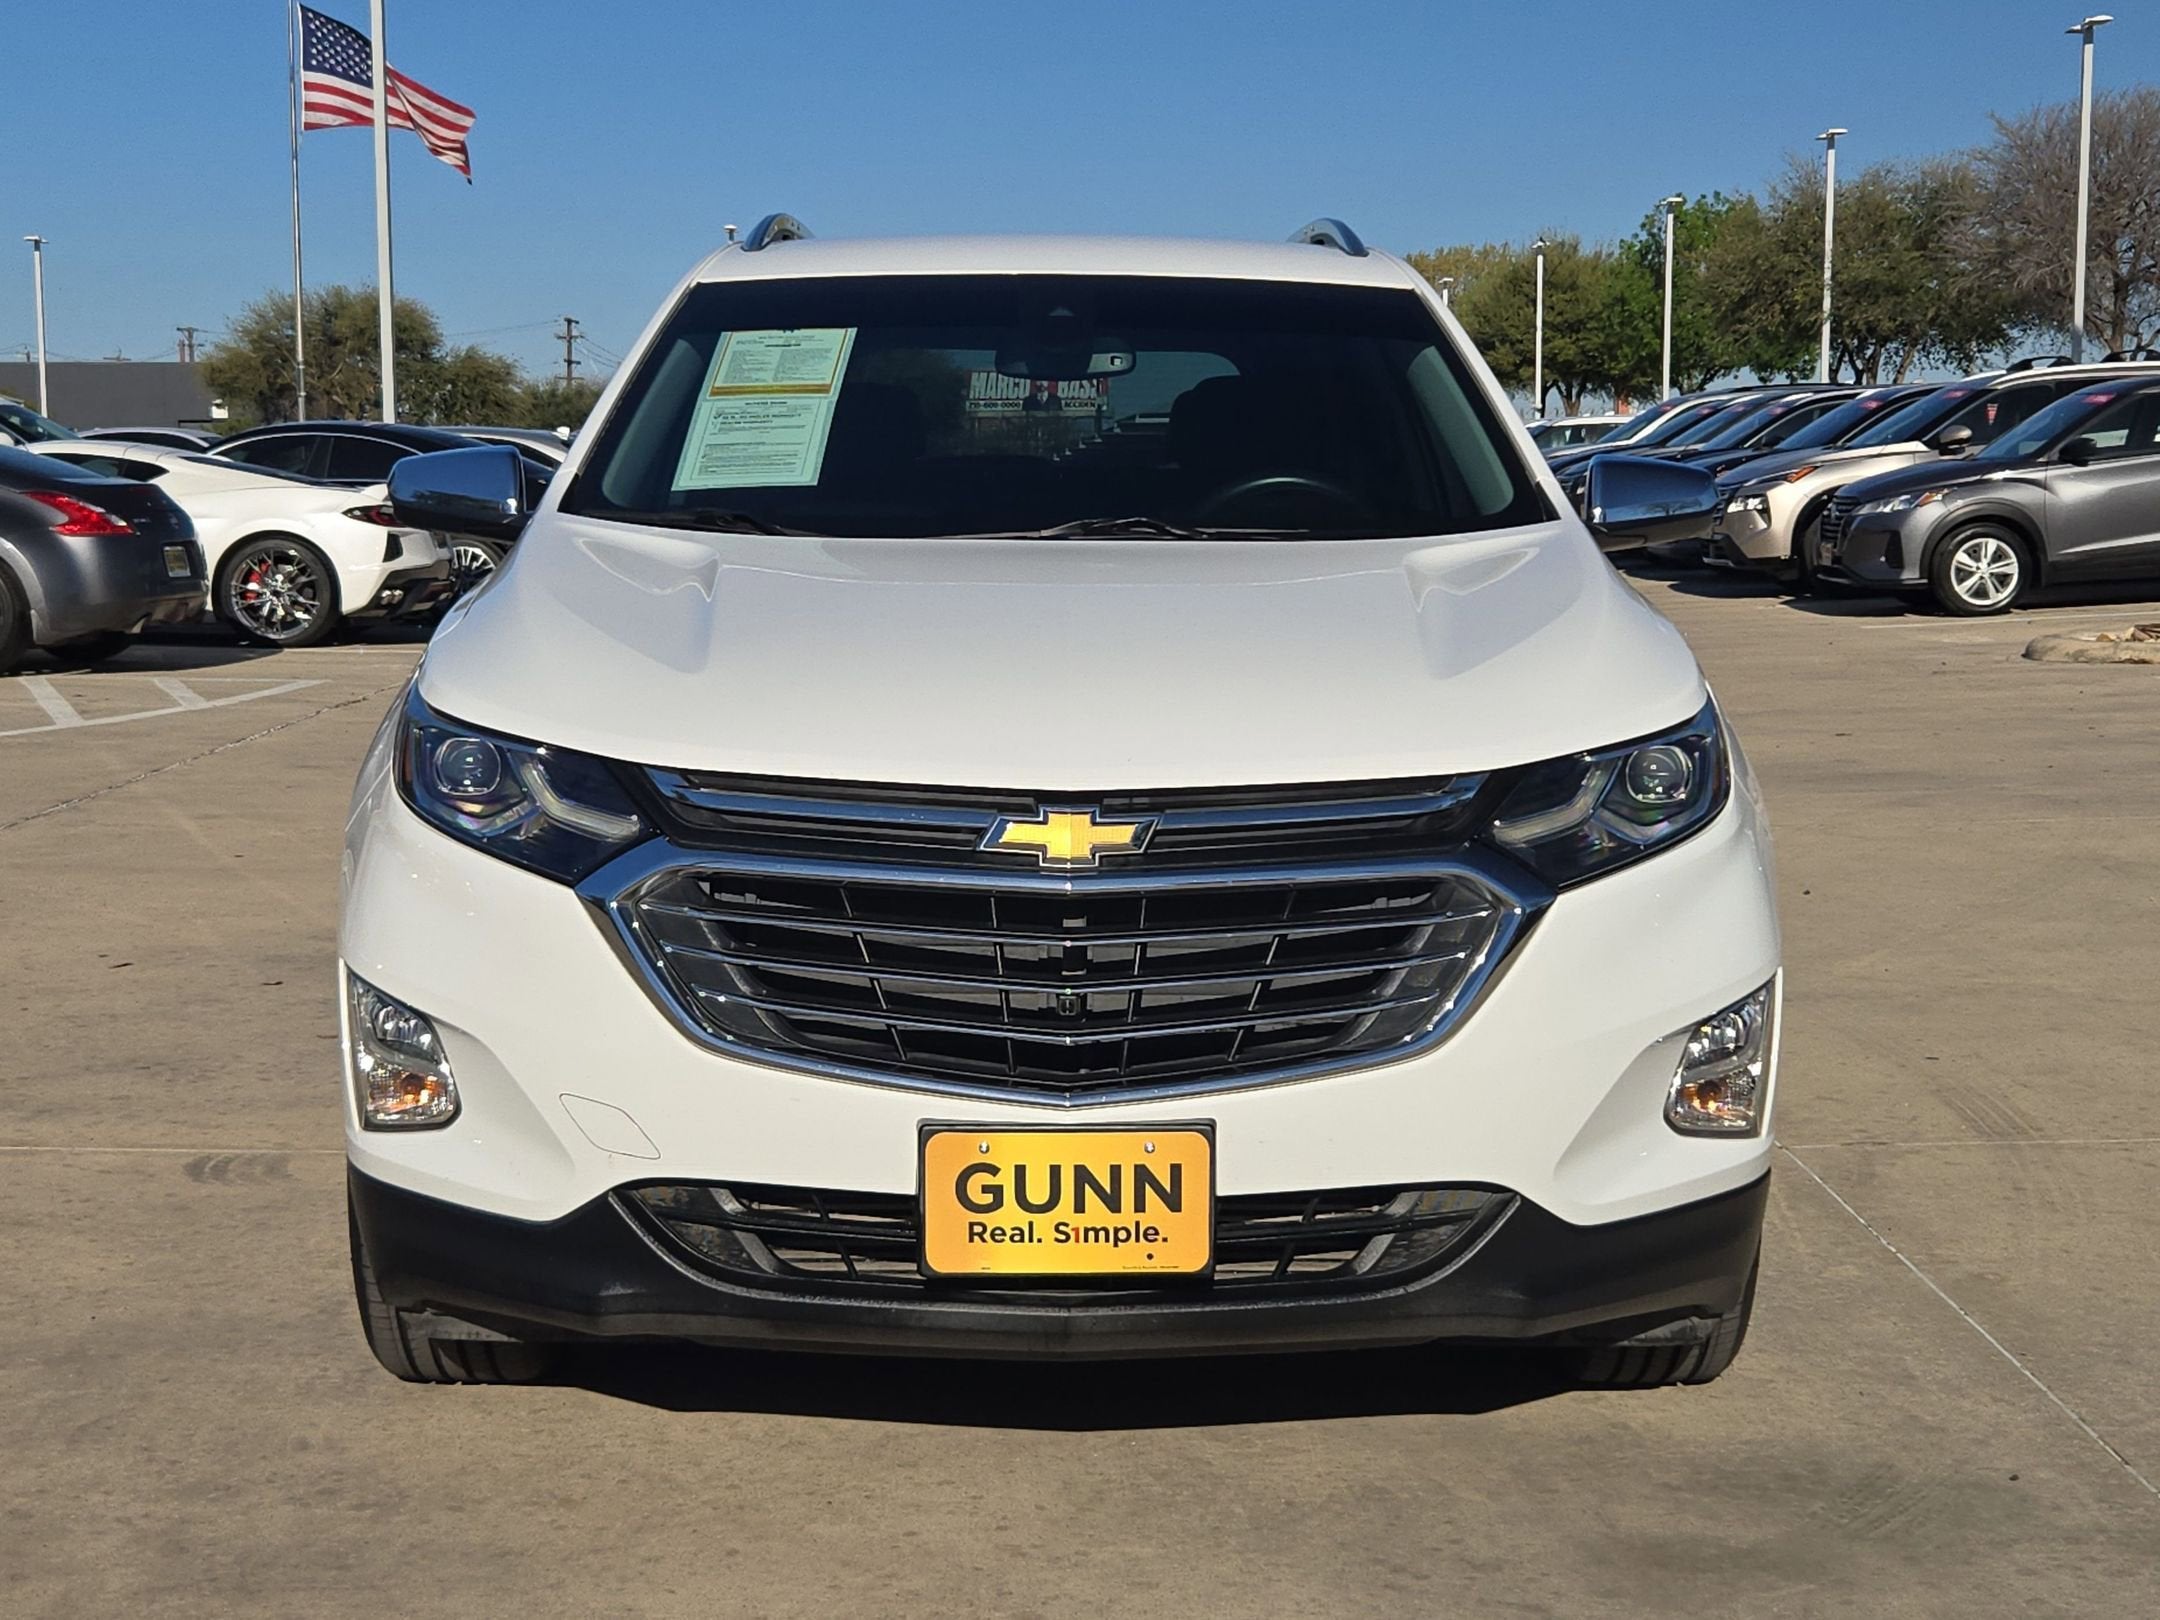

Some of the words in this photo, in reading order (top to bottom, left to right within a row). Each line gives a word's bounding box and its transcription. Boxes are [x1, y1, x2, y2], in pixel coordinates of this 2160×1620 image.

[969, 371, 1031, 399] MARCO
[1064, 401, 1098, 409] ACCIDEN
[955, 1162, 1182, 1214] GUNN
[968, 1221, 1043, 1243] Real.
